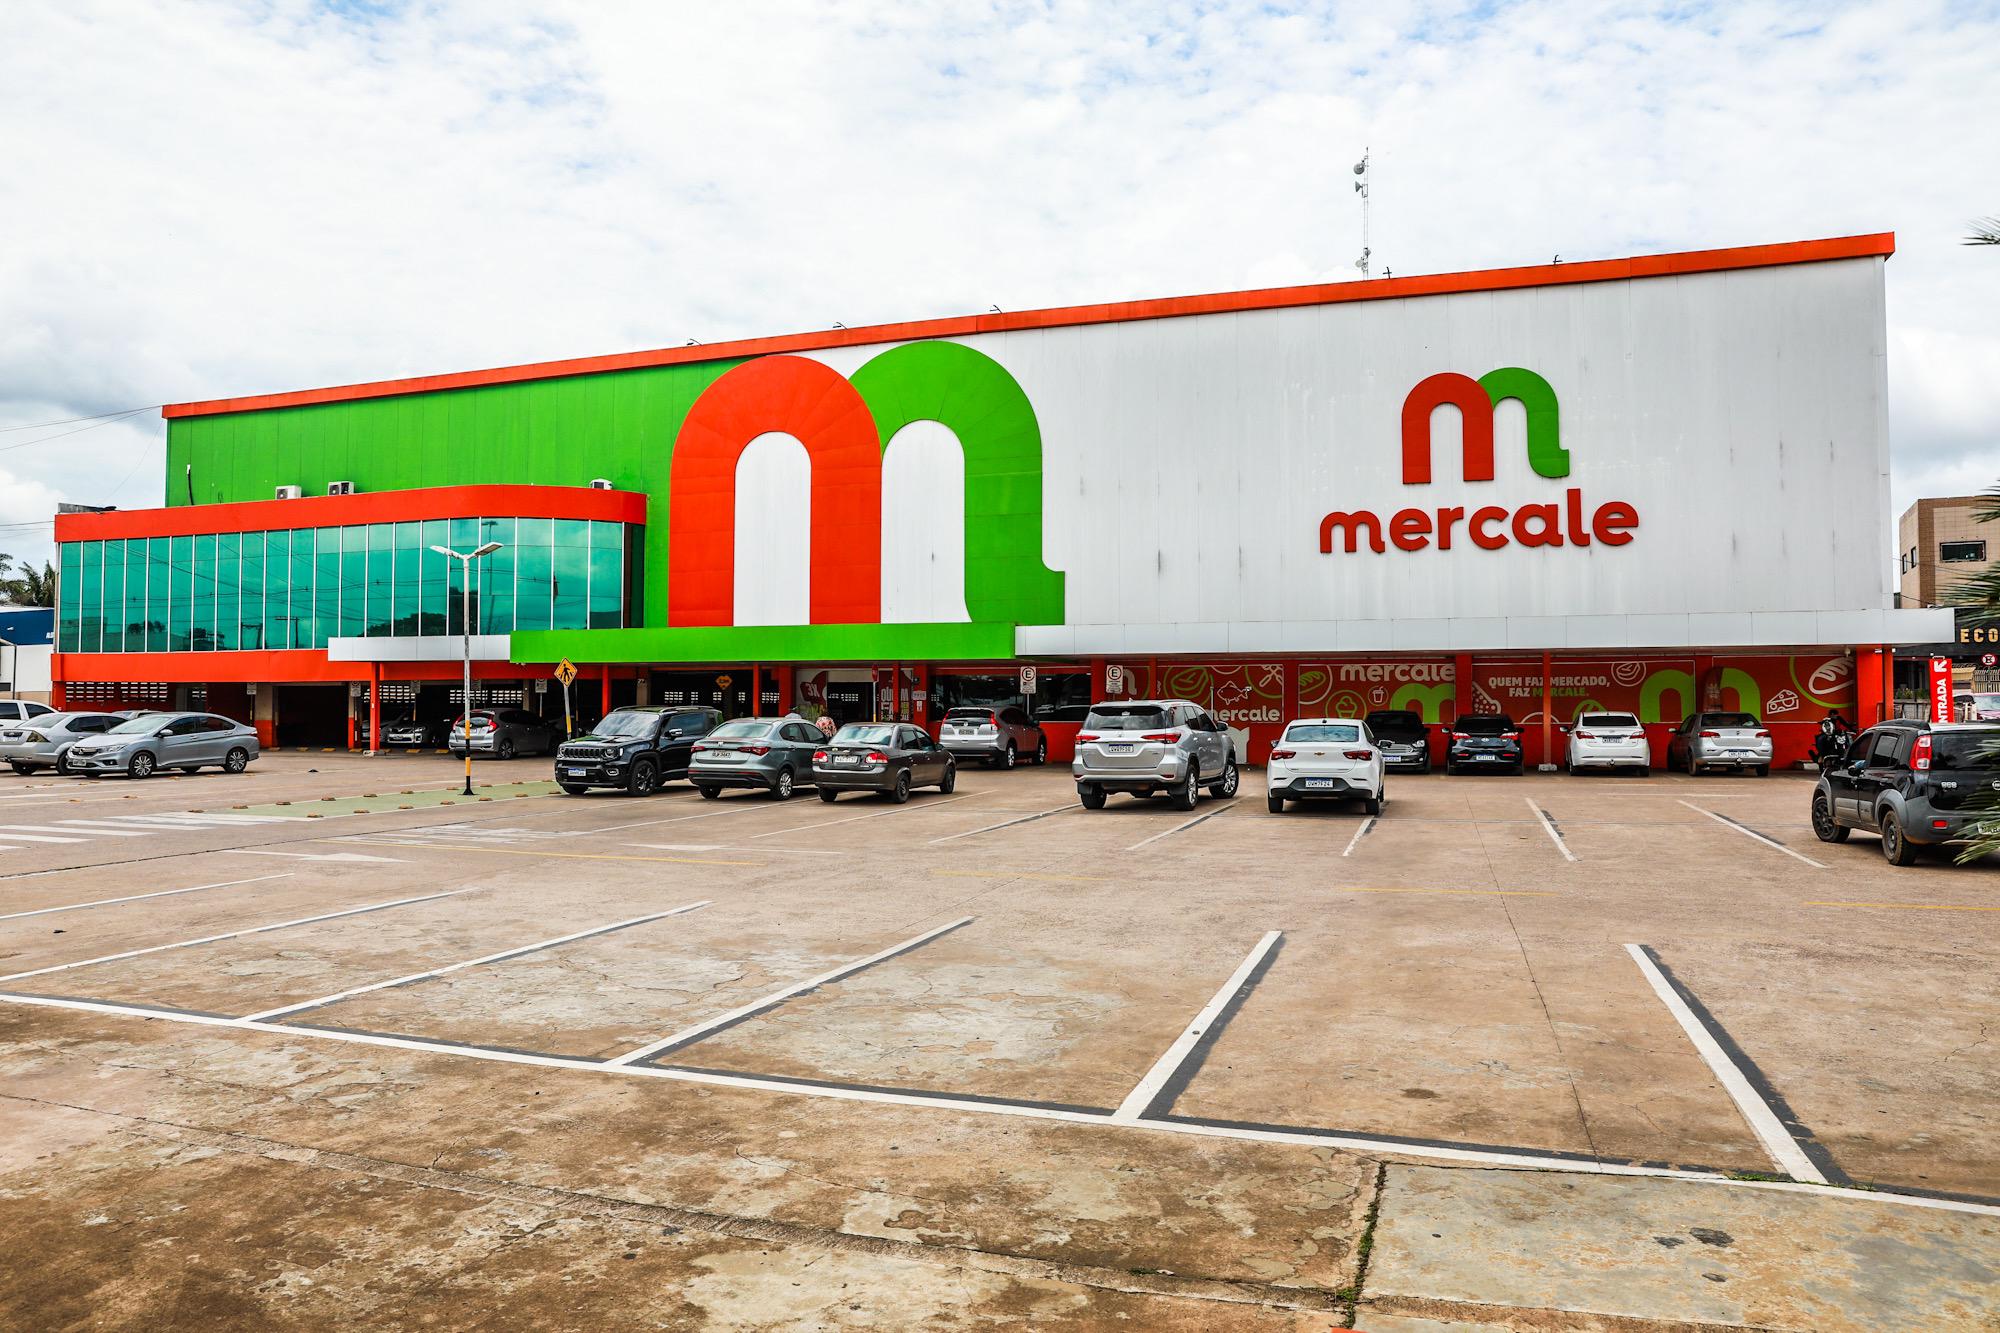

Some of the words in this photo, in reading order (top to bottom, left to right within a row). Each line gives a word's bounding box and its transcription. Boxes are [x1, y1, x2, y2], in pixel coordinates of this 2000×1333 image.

[1319, 488, 1639, 553] mercale
[1960, 628, 1999, 643] ECO
[1340, 664, 1456, 682] mercale
[1488, 677, 1522, 689] QUEM
[1509, 687, 1531, 697] FAZ
[1532, 687, 1590, 697] MRCALE.
[1936, 678, 1949, 723] NTRADA
